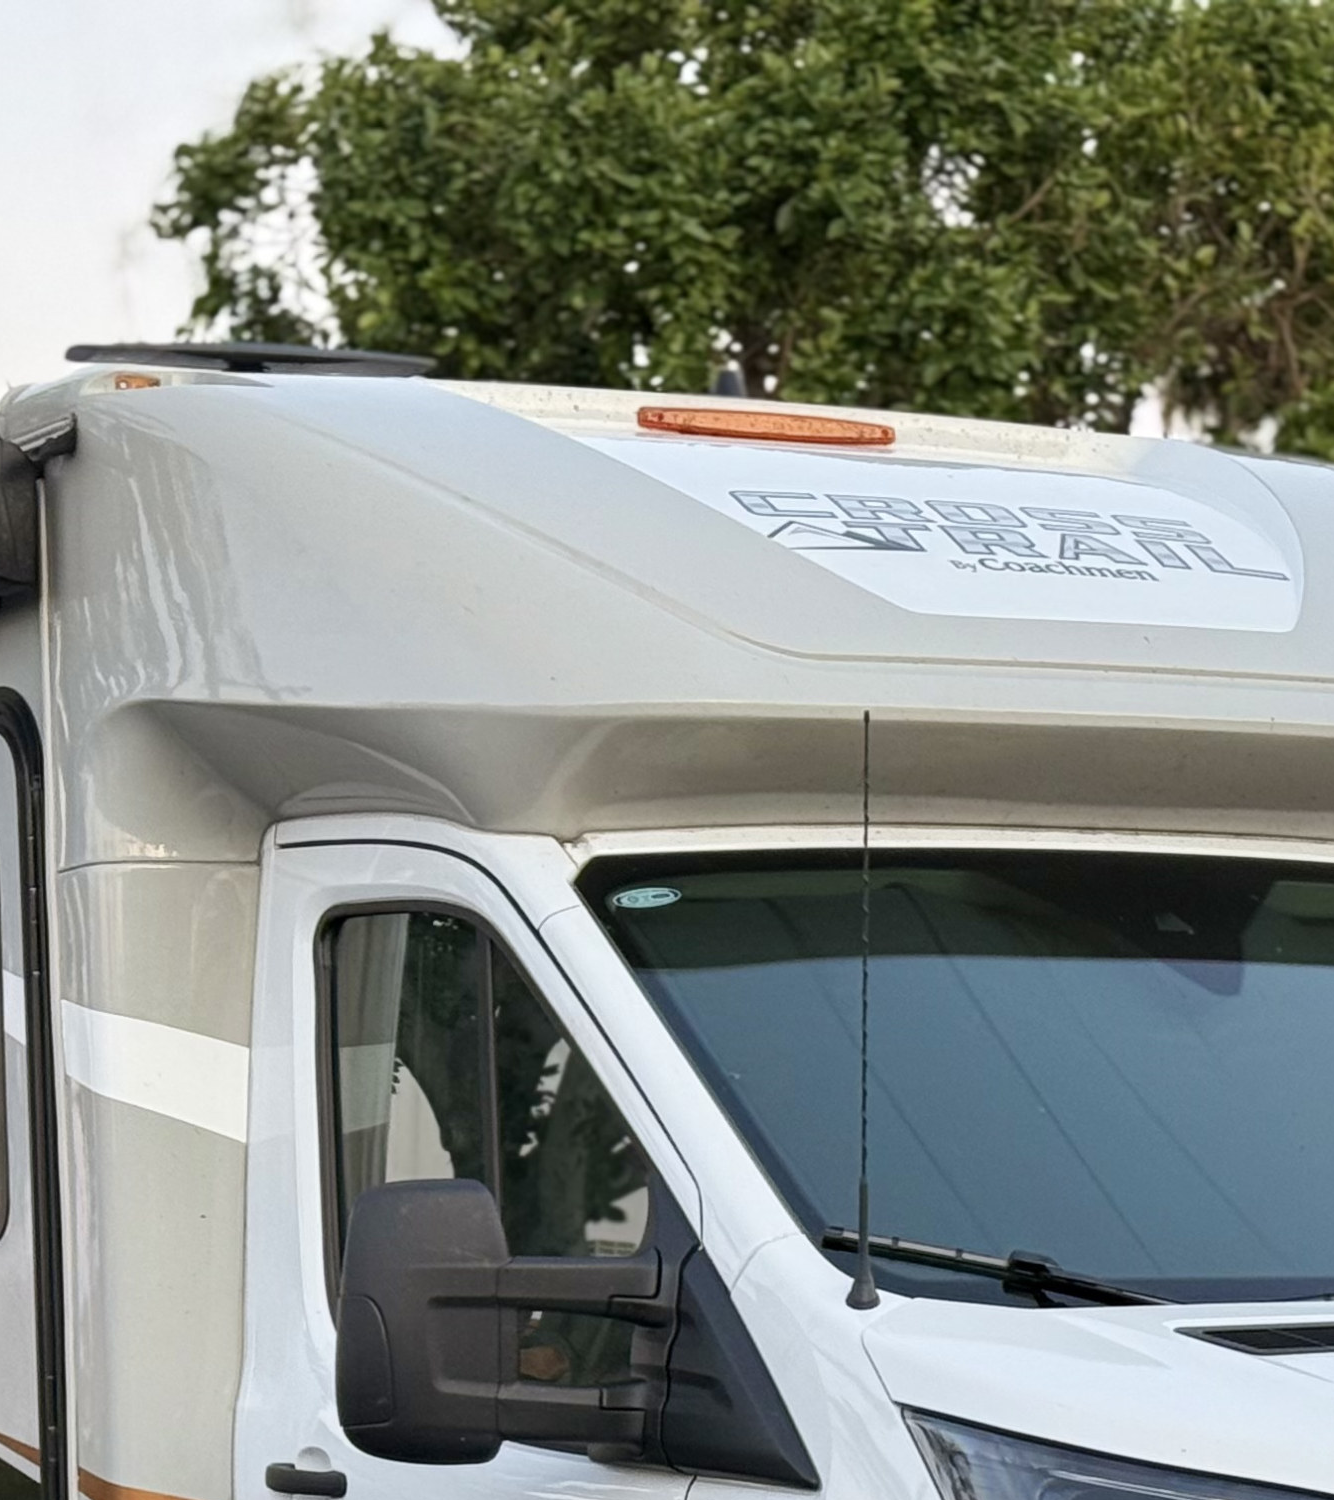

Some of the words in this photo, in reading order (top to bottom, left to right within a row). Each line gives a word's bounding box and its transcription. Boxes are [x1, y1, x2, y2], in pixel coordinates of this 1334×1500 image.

[728, 489, 1213, 545] CROSS
[840, 520, 1291, 582] TRAIL
[948, 559, 977, 573] By
[978, 557, 1160, 582] Coachmen
